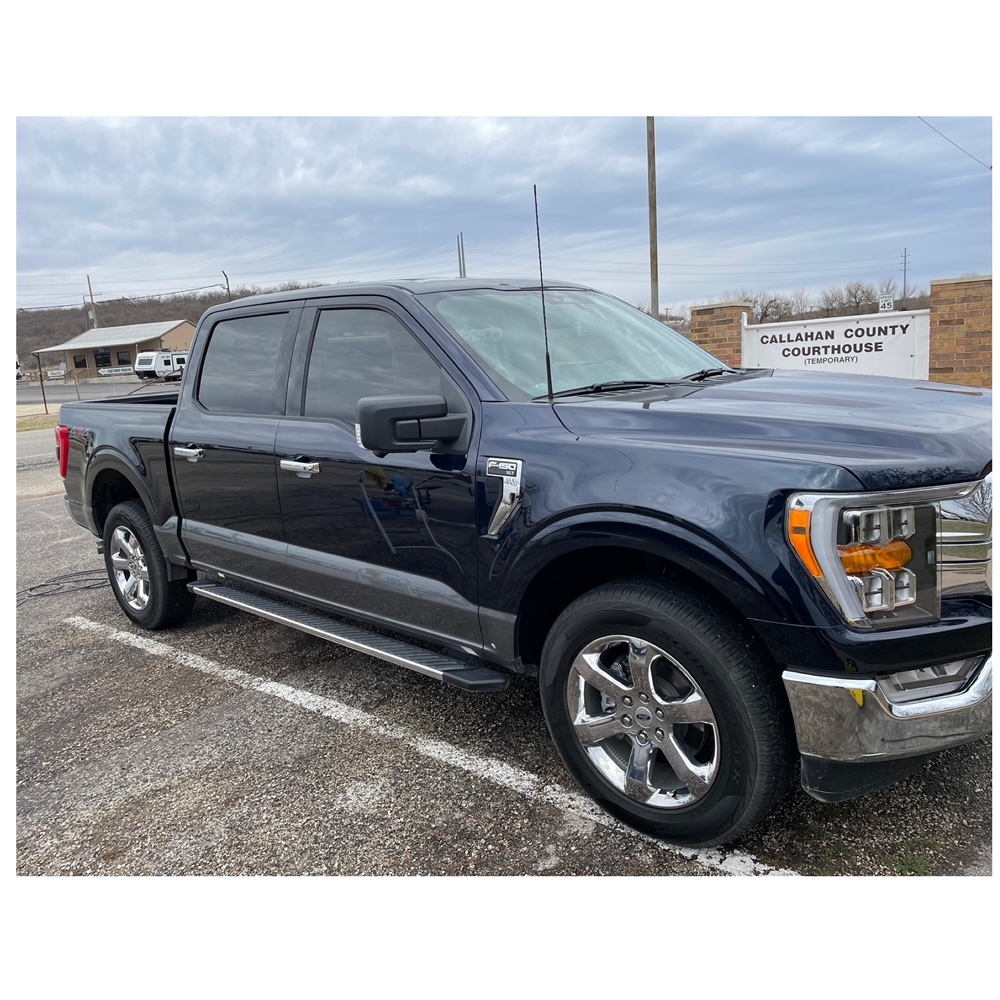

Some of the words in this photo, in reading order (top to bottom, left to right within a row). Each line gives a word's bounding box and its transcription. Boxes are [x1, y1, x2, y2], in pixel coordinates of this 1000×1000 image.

[760, 330, 835, 345] CALLAHAN
[844, 324, 910, 339] COUNTY
[782, 341, 883, 358] COURTHOUSE
[804, 356, 858, 366] (TEMPORARY)
